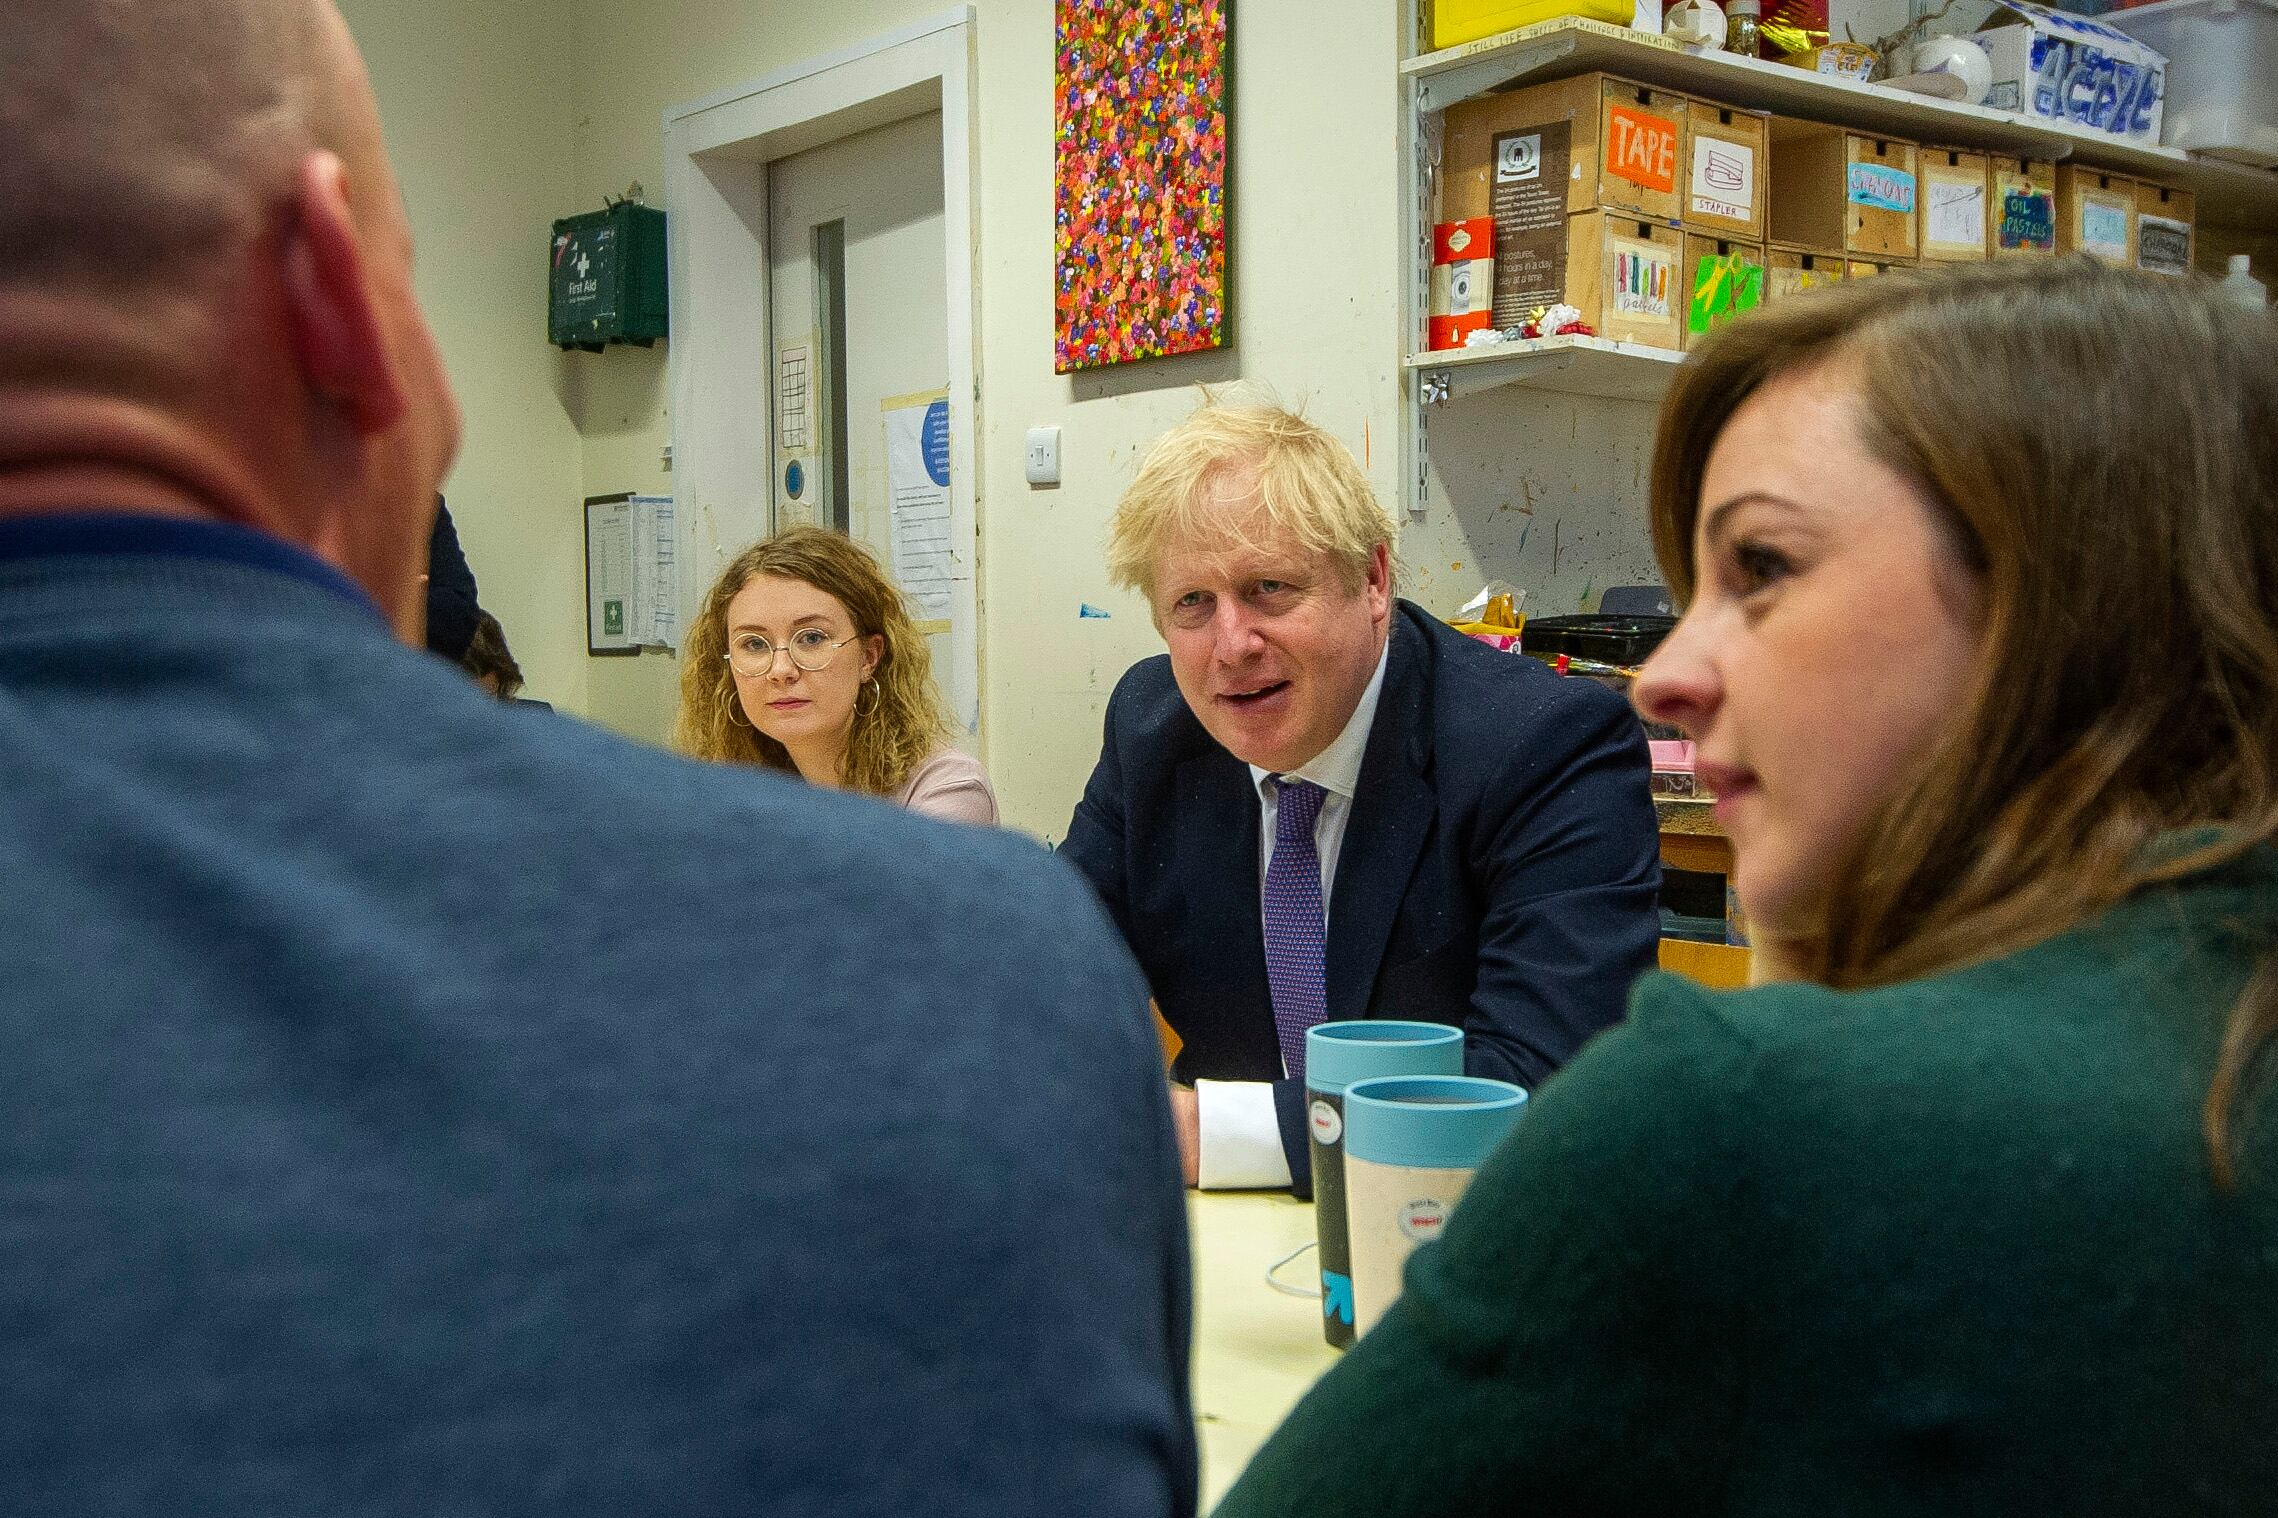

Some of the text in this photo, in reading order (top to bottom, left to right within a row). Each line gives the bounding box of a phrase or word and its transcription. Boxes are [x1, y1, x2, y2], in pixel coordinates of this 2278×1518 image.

[1468, 41, 1495, 53] STILL
[1499, 32, 1522, 46] LIFE
[1614, 115, 1674, 179] TAPE
[1699, 199, 1737, 216] STAPLER
[2010, 198, 2031, 215] OIL
[2004, 216, 2047, 238] PASTELS
[569, 279, 597, 295] First Aid
